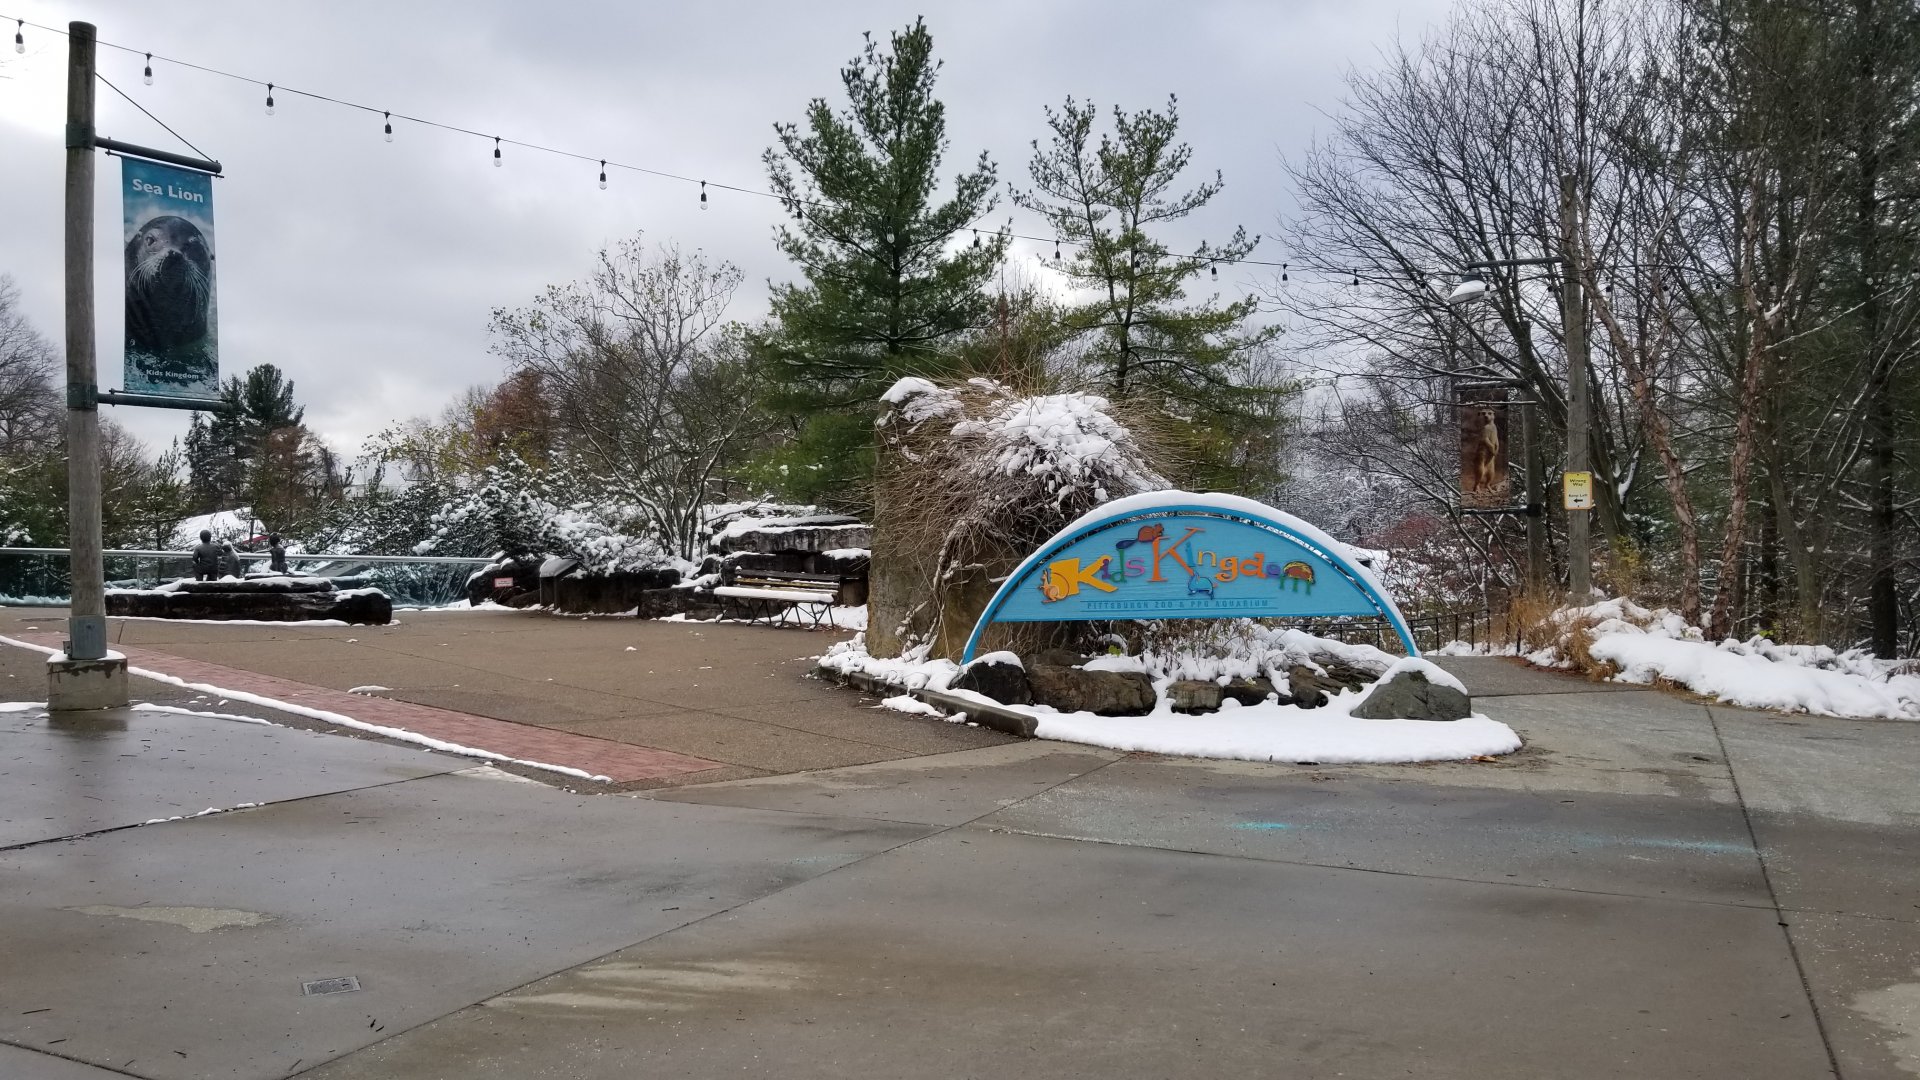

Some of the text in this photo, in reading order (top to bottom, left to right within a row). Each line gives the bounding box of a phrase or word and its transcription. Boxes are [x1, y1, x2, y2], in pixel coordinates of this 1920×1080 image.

[132, 178, 204, 203] Sea Lion
[165, 370, 199, 379] Kingdom
[1048, 527, 1316, 596] Kids Kingdom
[1087, 599, 1269, 610] PITTSBURGH ZOO & PPG AQUARIUM
